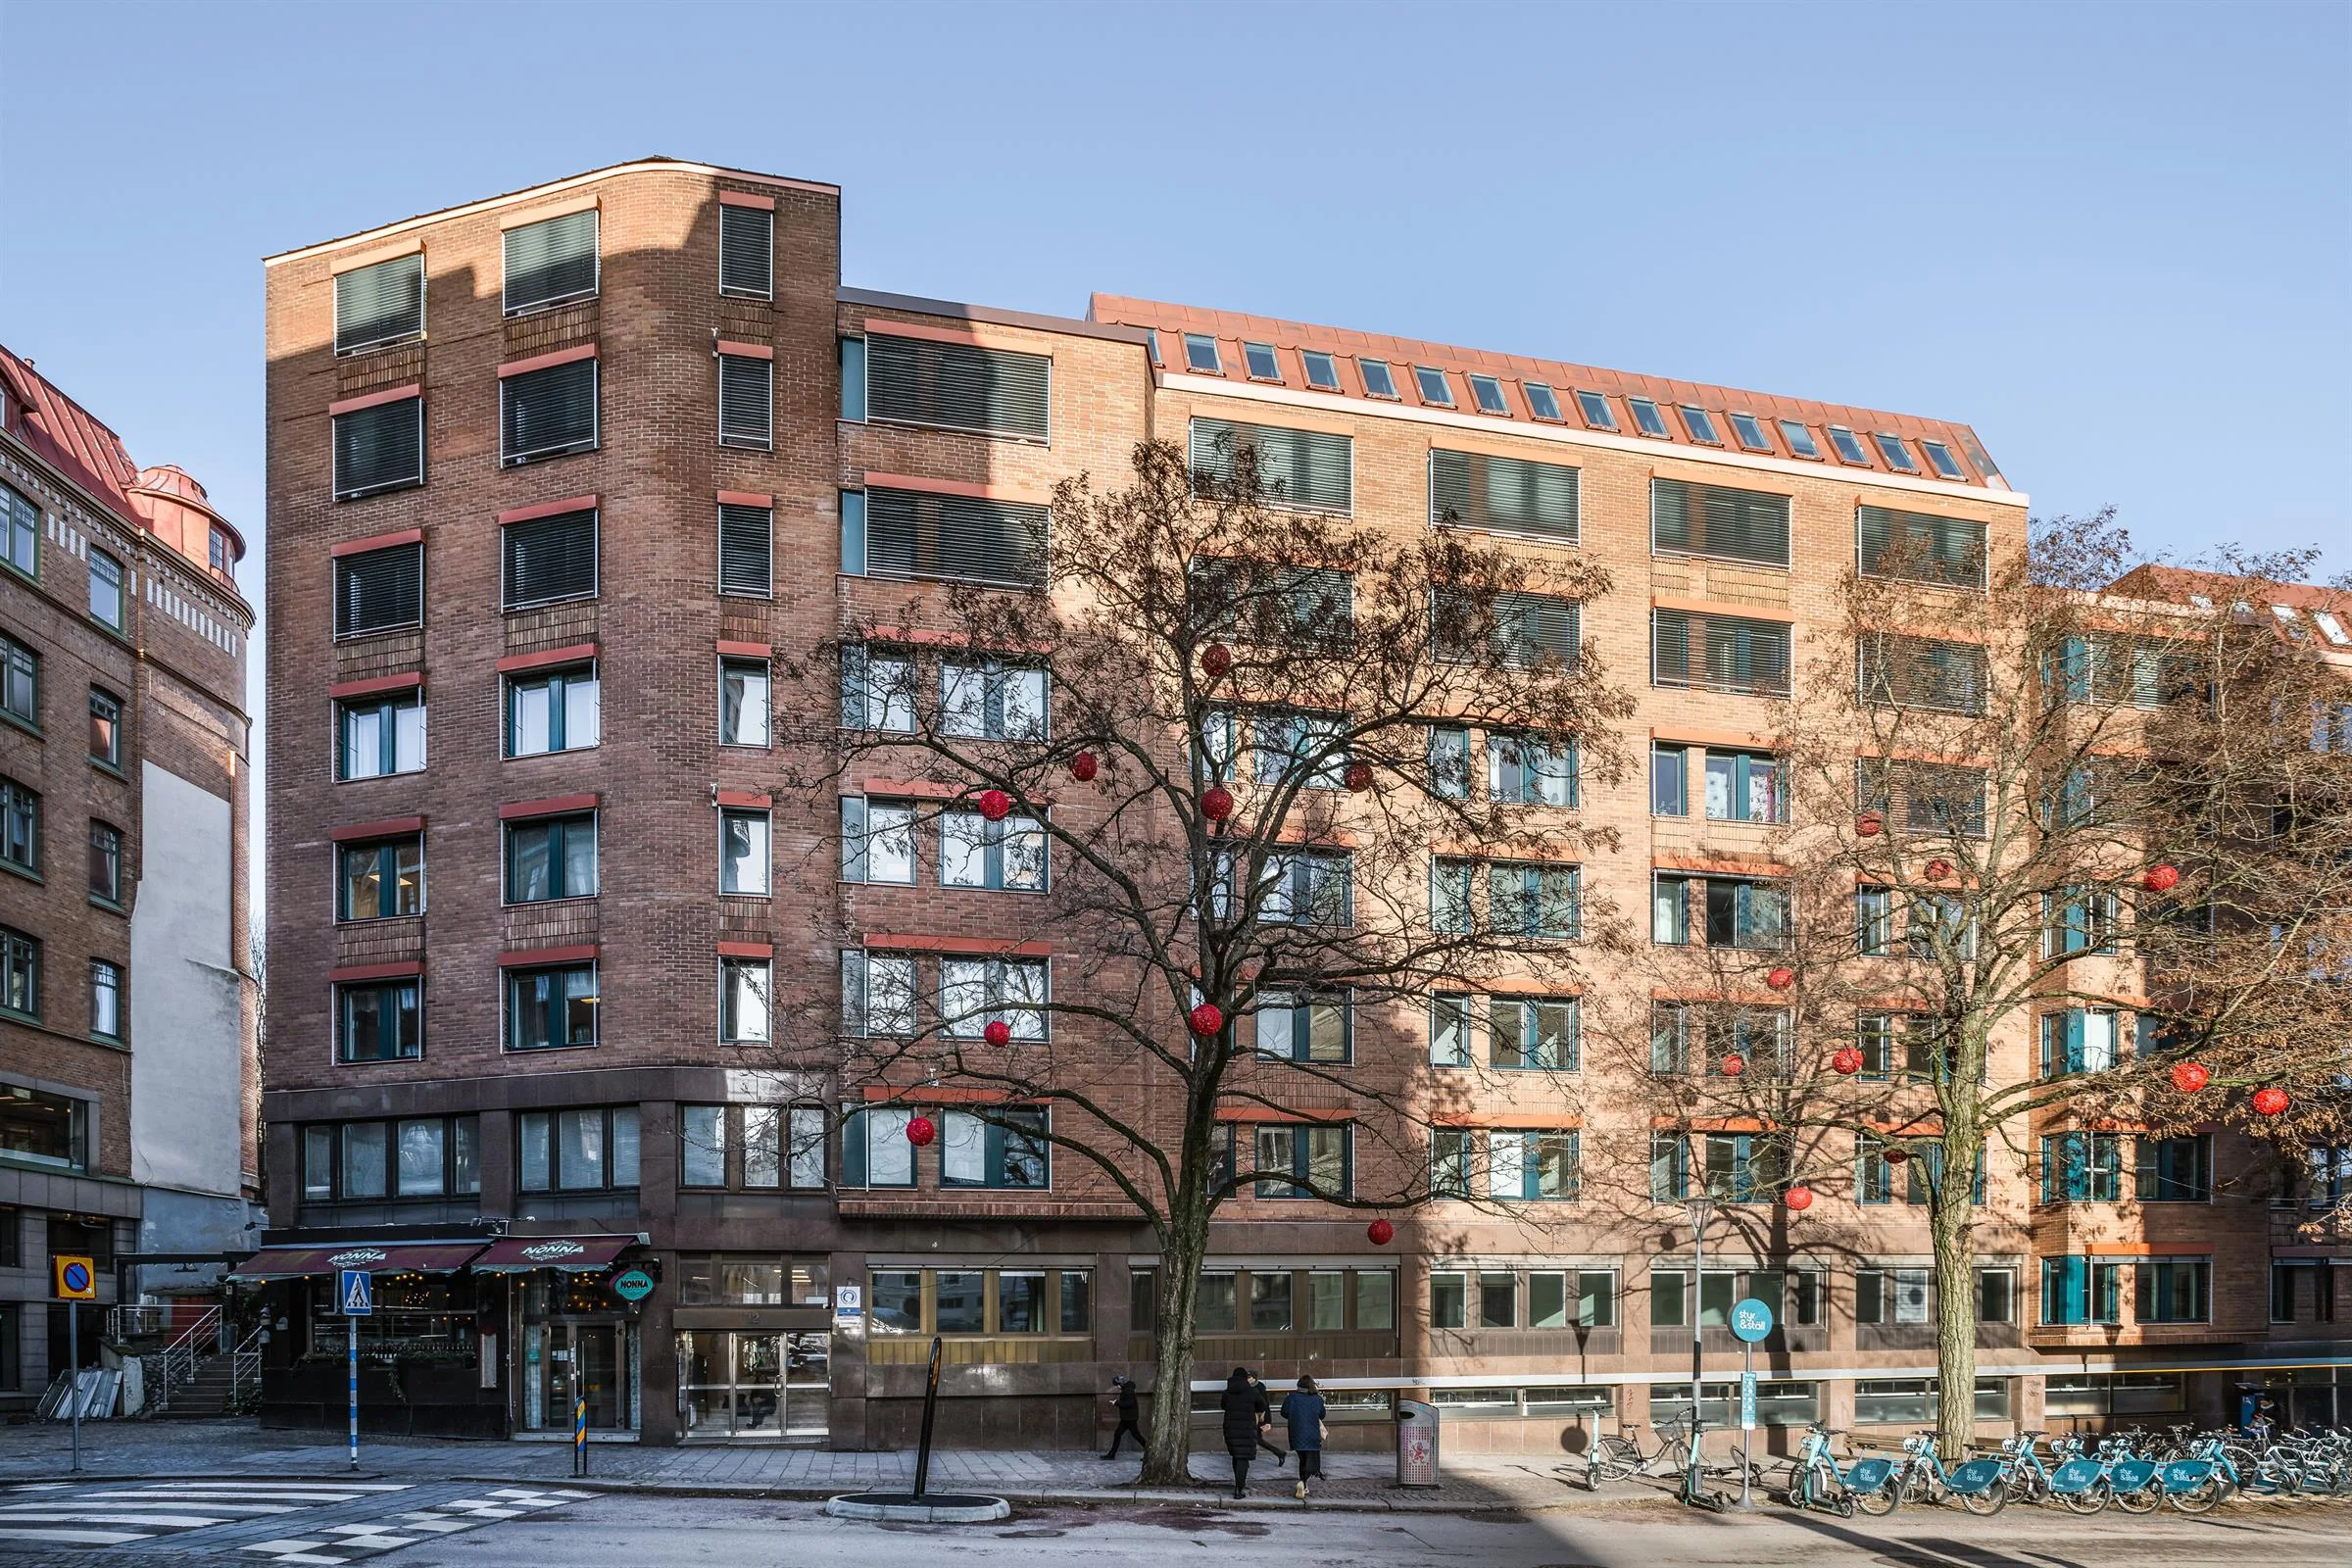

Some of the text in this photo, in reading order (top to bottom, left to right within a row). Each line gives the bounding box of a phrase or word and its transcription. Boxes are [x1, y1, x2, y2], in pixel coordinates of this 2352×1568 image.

[520, 1246, 584, 1254] NONNA
[327, 1252, 386, 1262] NONNA
[620, 1279, 649, 1289] NONNA
[1739, 1309, 1756, 1322] styr
